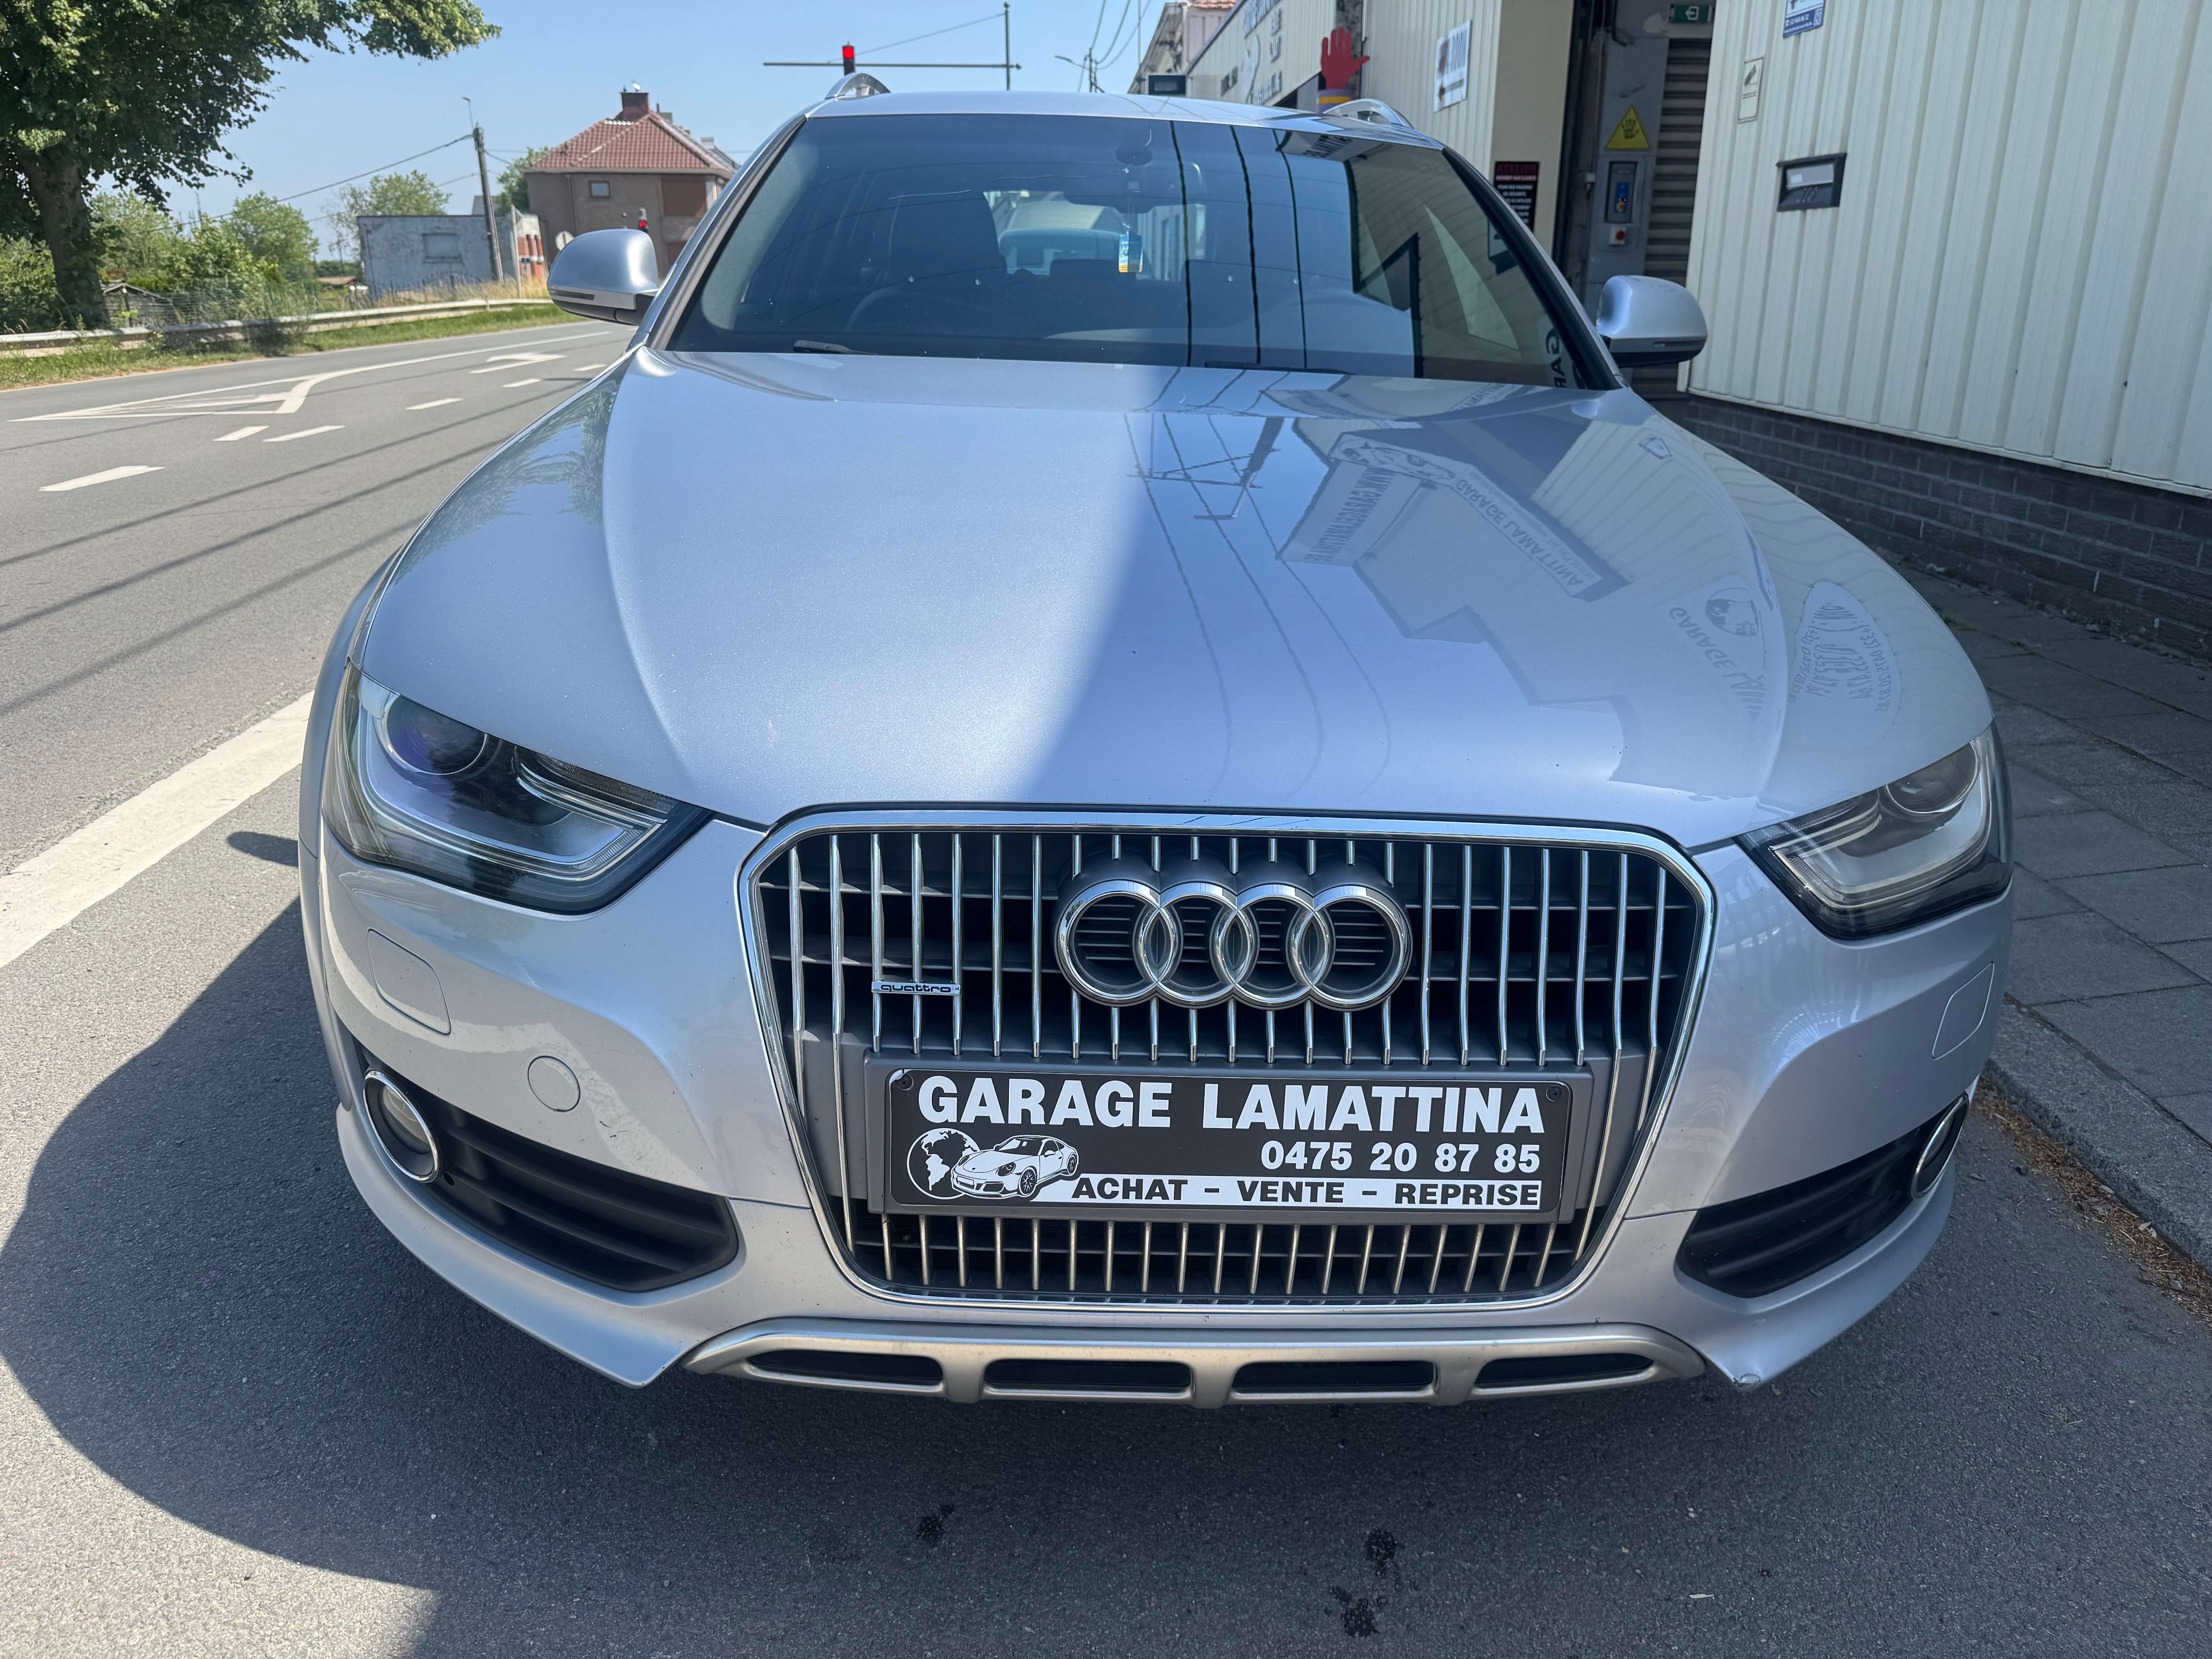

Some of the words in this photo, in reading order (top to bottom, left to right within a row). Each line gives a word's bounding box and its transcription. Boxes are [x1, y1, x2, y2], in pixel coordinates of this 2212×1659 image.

[881, 984, 951, 993] quattro
[919, 1075, 1172, 1128] GARAGE
[1203, 1083, 1545, 1133] LAMATTINA
[1261, 1140, 1352, 1170] 0475
[1370, 1142, 1417, 1172] 20
[1434, 1143, 1479, 1172] 87
[1494, 1144, 1540, 1173] 85
[1071, 1177, 1188, 1201] ACHAT
[1237, 1180, 1345, 1203] VENTE
[1395, 1183, 1538, 1206] REPRISE
